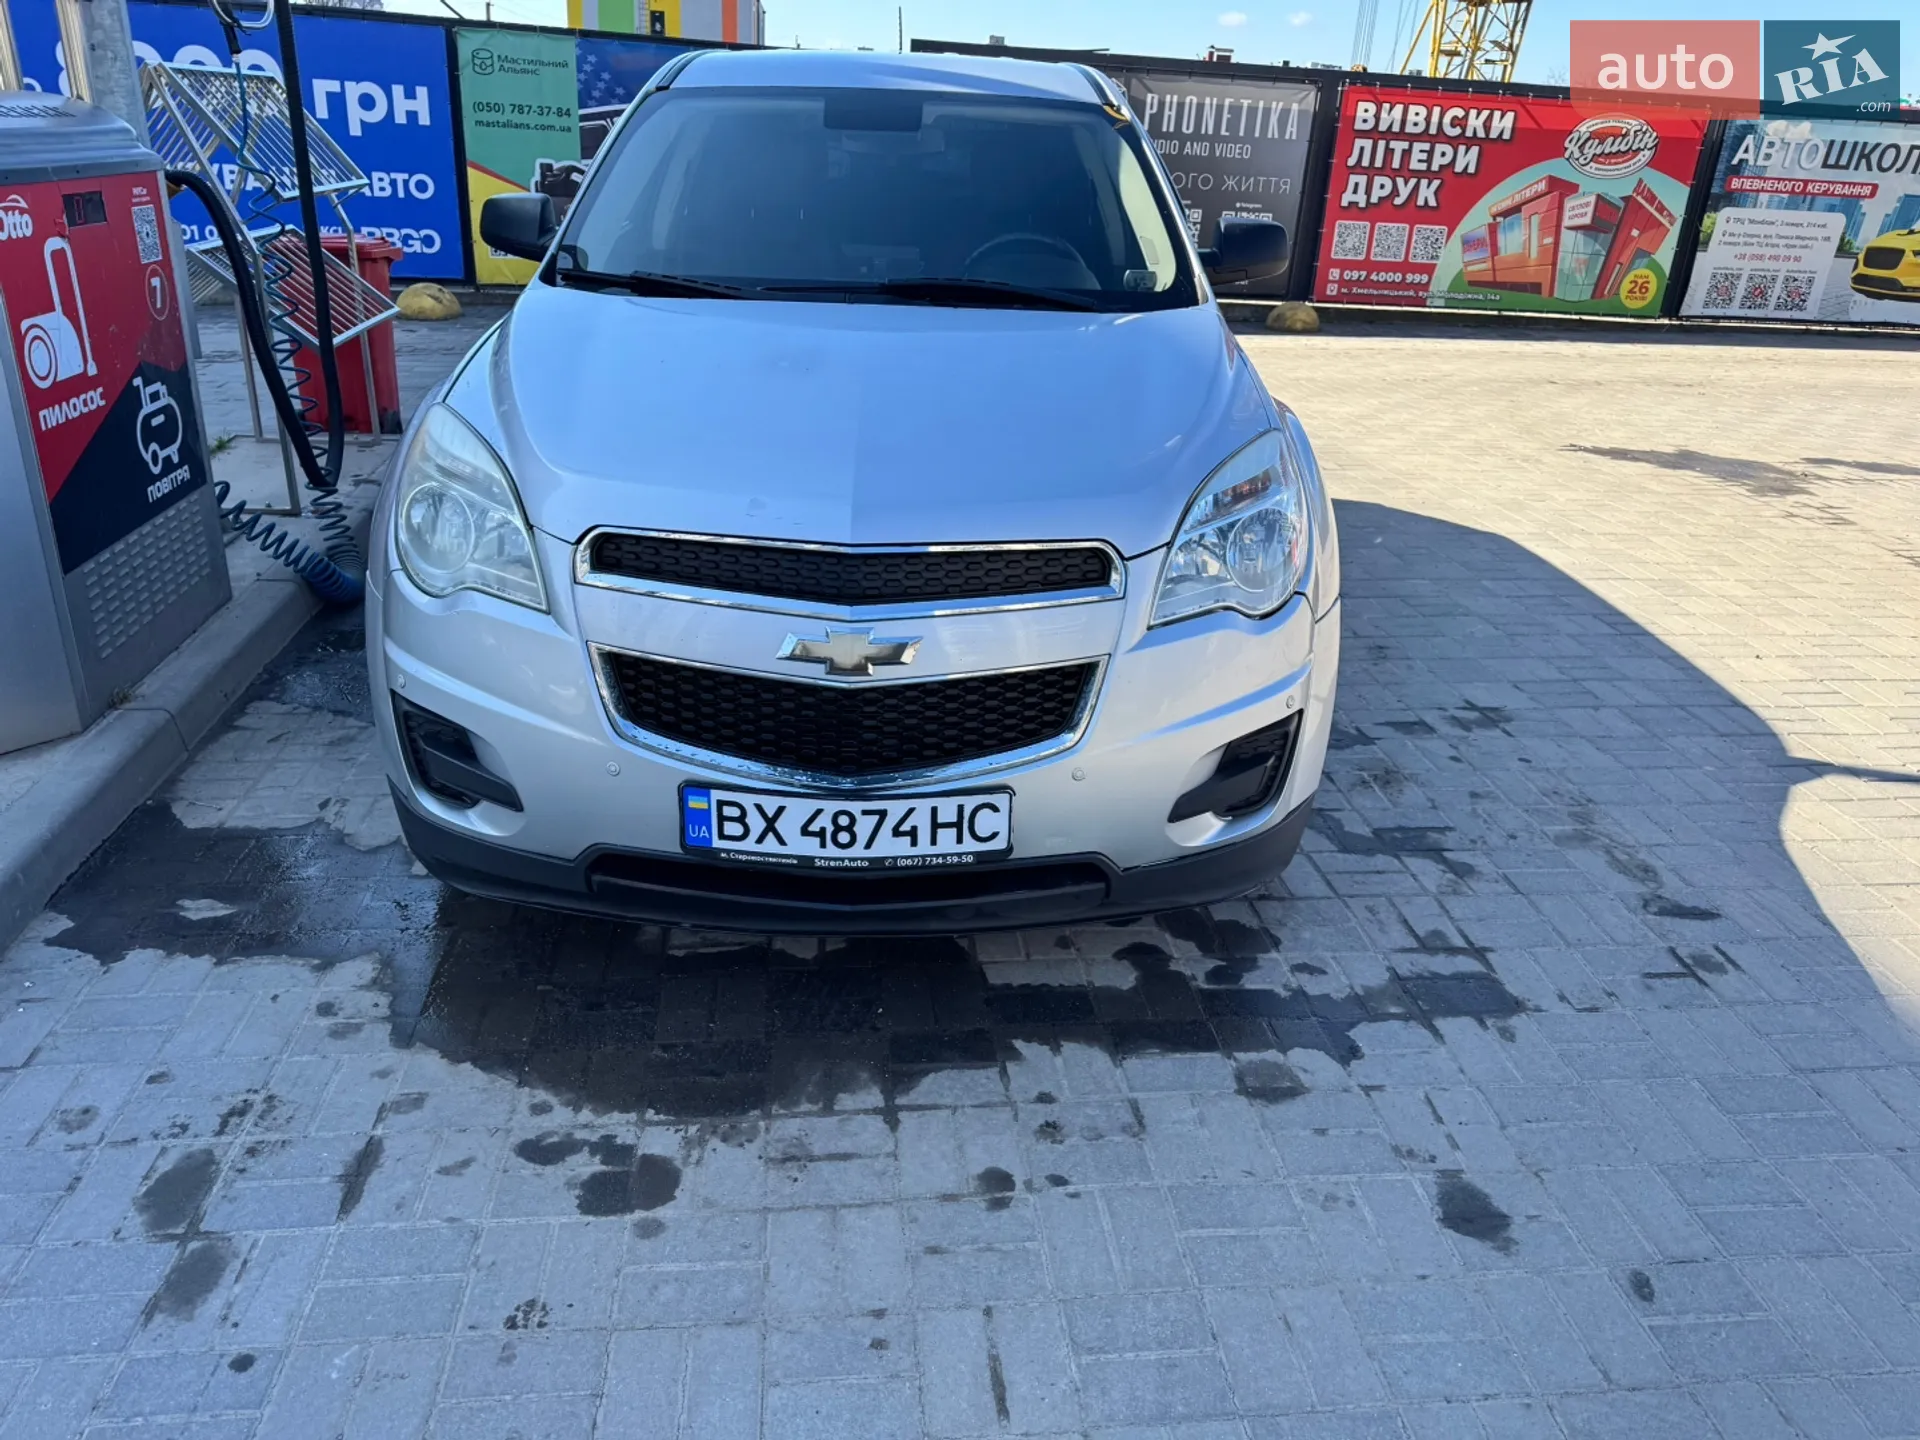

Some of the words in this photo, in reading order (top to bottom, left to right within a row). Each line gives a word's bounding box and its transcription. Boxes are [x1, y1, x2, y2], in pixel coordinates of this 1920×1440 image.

[497, 55, 569, 68] Мастильний
[498, 65, 541, 76] Альянс
[312, 79, 431, 136] грн
[473, 101, 505, 115] (050)
[509, 104, 572, 118] 787-37-84
[1144, 93, 1298, 140] PHONETIKA
[475, 119, 572, 133] mastalians.com.ua
[1353, 101, 1515, 140] ВИВІСКИ
[1155, 139, 1179, 154] DIO
[1183, 141, 1210, 156] AND
[1215, 142, 1252, 158] VIDEO
[1347, 138, 1480, 174] ЛІТЕРИ
[1731, 134, 1920, 175] АВТОШКОЛ
[1221, 174, 1291, 195] ЖИТТЯ
[1340, 174, 1442, 208] ДРУК
[1731, 178, 1804, 193] ВПЕВНЕНОГО
[1806, 182, 1872, 196] КЕРУВАННЯ
[1343, 269, 1367, 281] 097
[1370, 271, 1403, 283] 4000
[1405, 272, 1429, 284] 999
[1627, 280, 1650, 295] 26
[38, 387, 106, 431] ПИЛОСОС
[147, 465, 191, 503] ПОВІТРЯ
[689, 823, 710, 839] UA
[716, 799, 788, 847] BX
[800, 807, 918, 850] 4874
[930, 802, 1000, 845] HC
[814, 858, 870, 868] StrenAuto
[897, 857, 922, 867] (067)
[925, 854, 974, 865] 734-59-50
